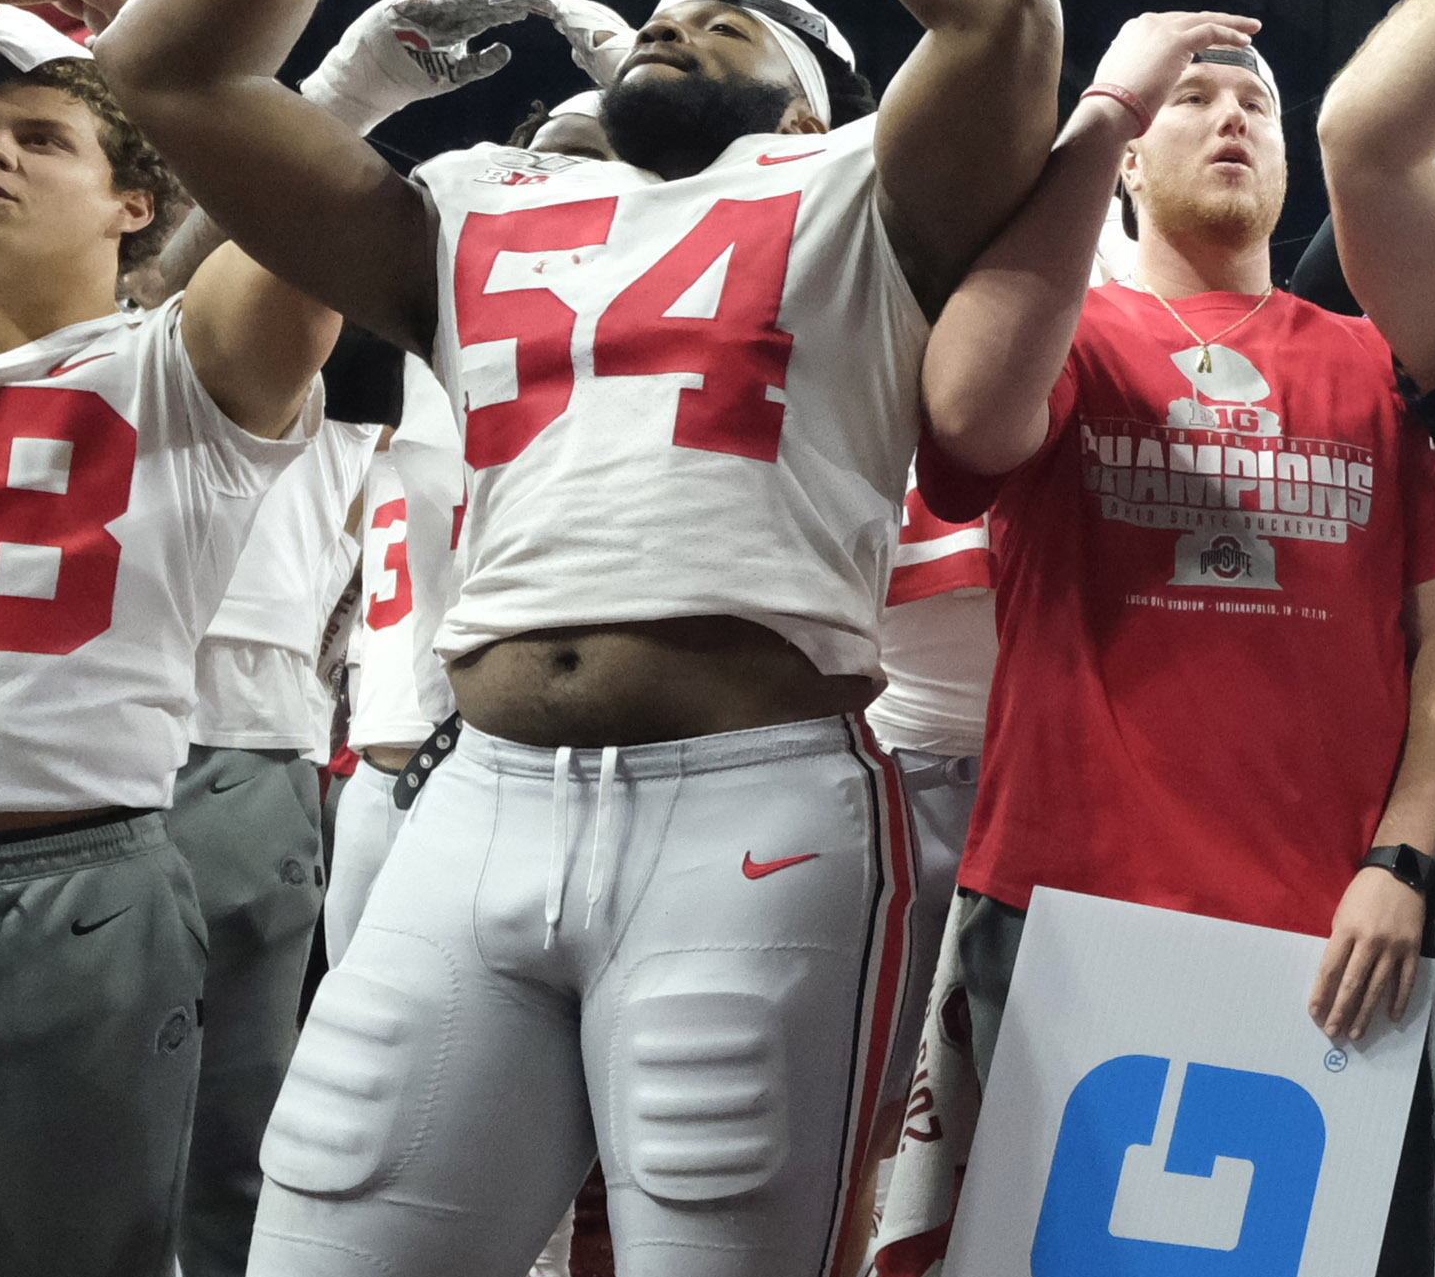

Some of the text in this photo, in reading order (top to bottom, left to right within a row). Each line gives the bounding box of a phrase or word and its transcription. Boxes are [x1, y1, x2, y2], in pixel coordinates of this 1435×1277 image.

[454, 190, 803, 471] 54
[1080, 424, 1374, 525] CHAMPIONS
[1170, 510, 1230, 529] STATE
[1244, 517, 1338, 539] BUCKEYES
[1167, 599, 1205, 612] STADIUM
